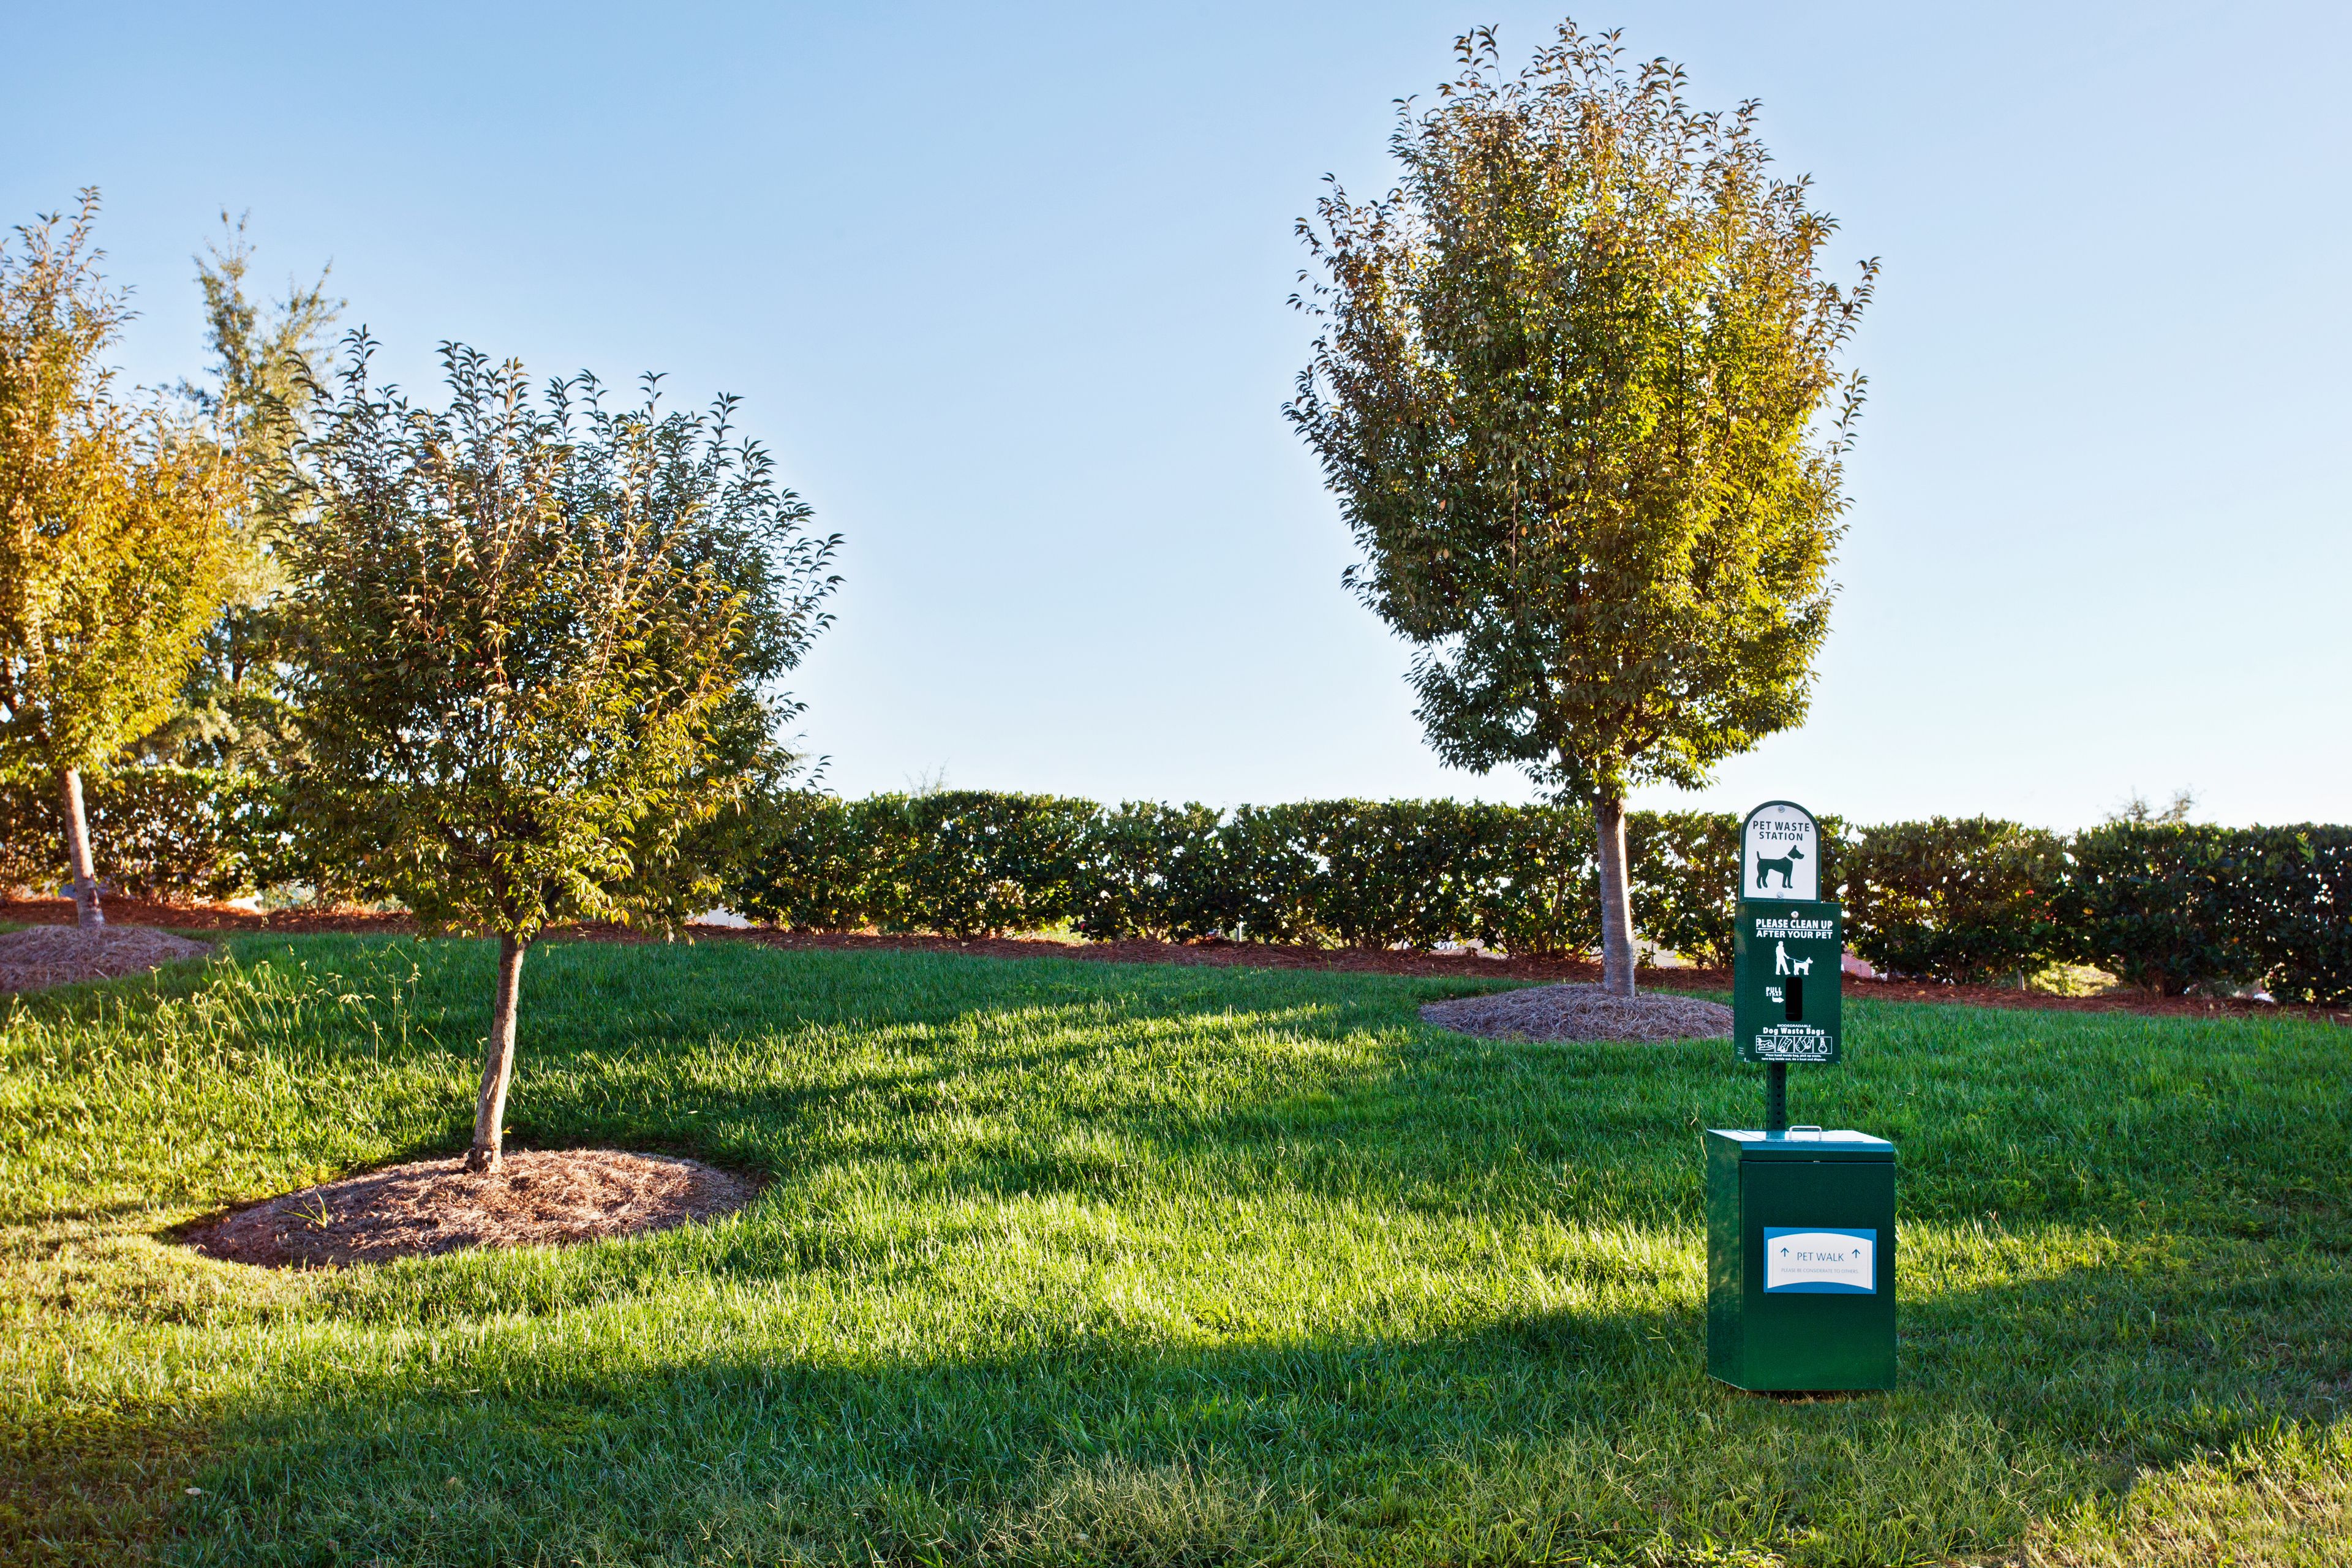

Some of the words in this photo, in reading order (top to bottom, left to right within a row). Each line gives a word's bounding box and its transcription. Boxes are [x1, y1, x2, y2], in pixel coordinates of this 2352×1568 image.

[1753, 821, 1771, 830] PET
[1775, 821, 1810, 832] WASTE
[1759, 831, 1803, 841] STATION
[1756, 919, 1788, 928] PLEASE
[1790, 920, 1819, 929] CLEAN
[1821, 921, 1833, 929] UP
[1797, 1252, 1813, 1261] PET
[1817, 1253, 1844, 1261] WALK
